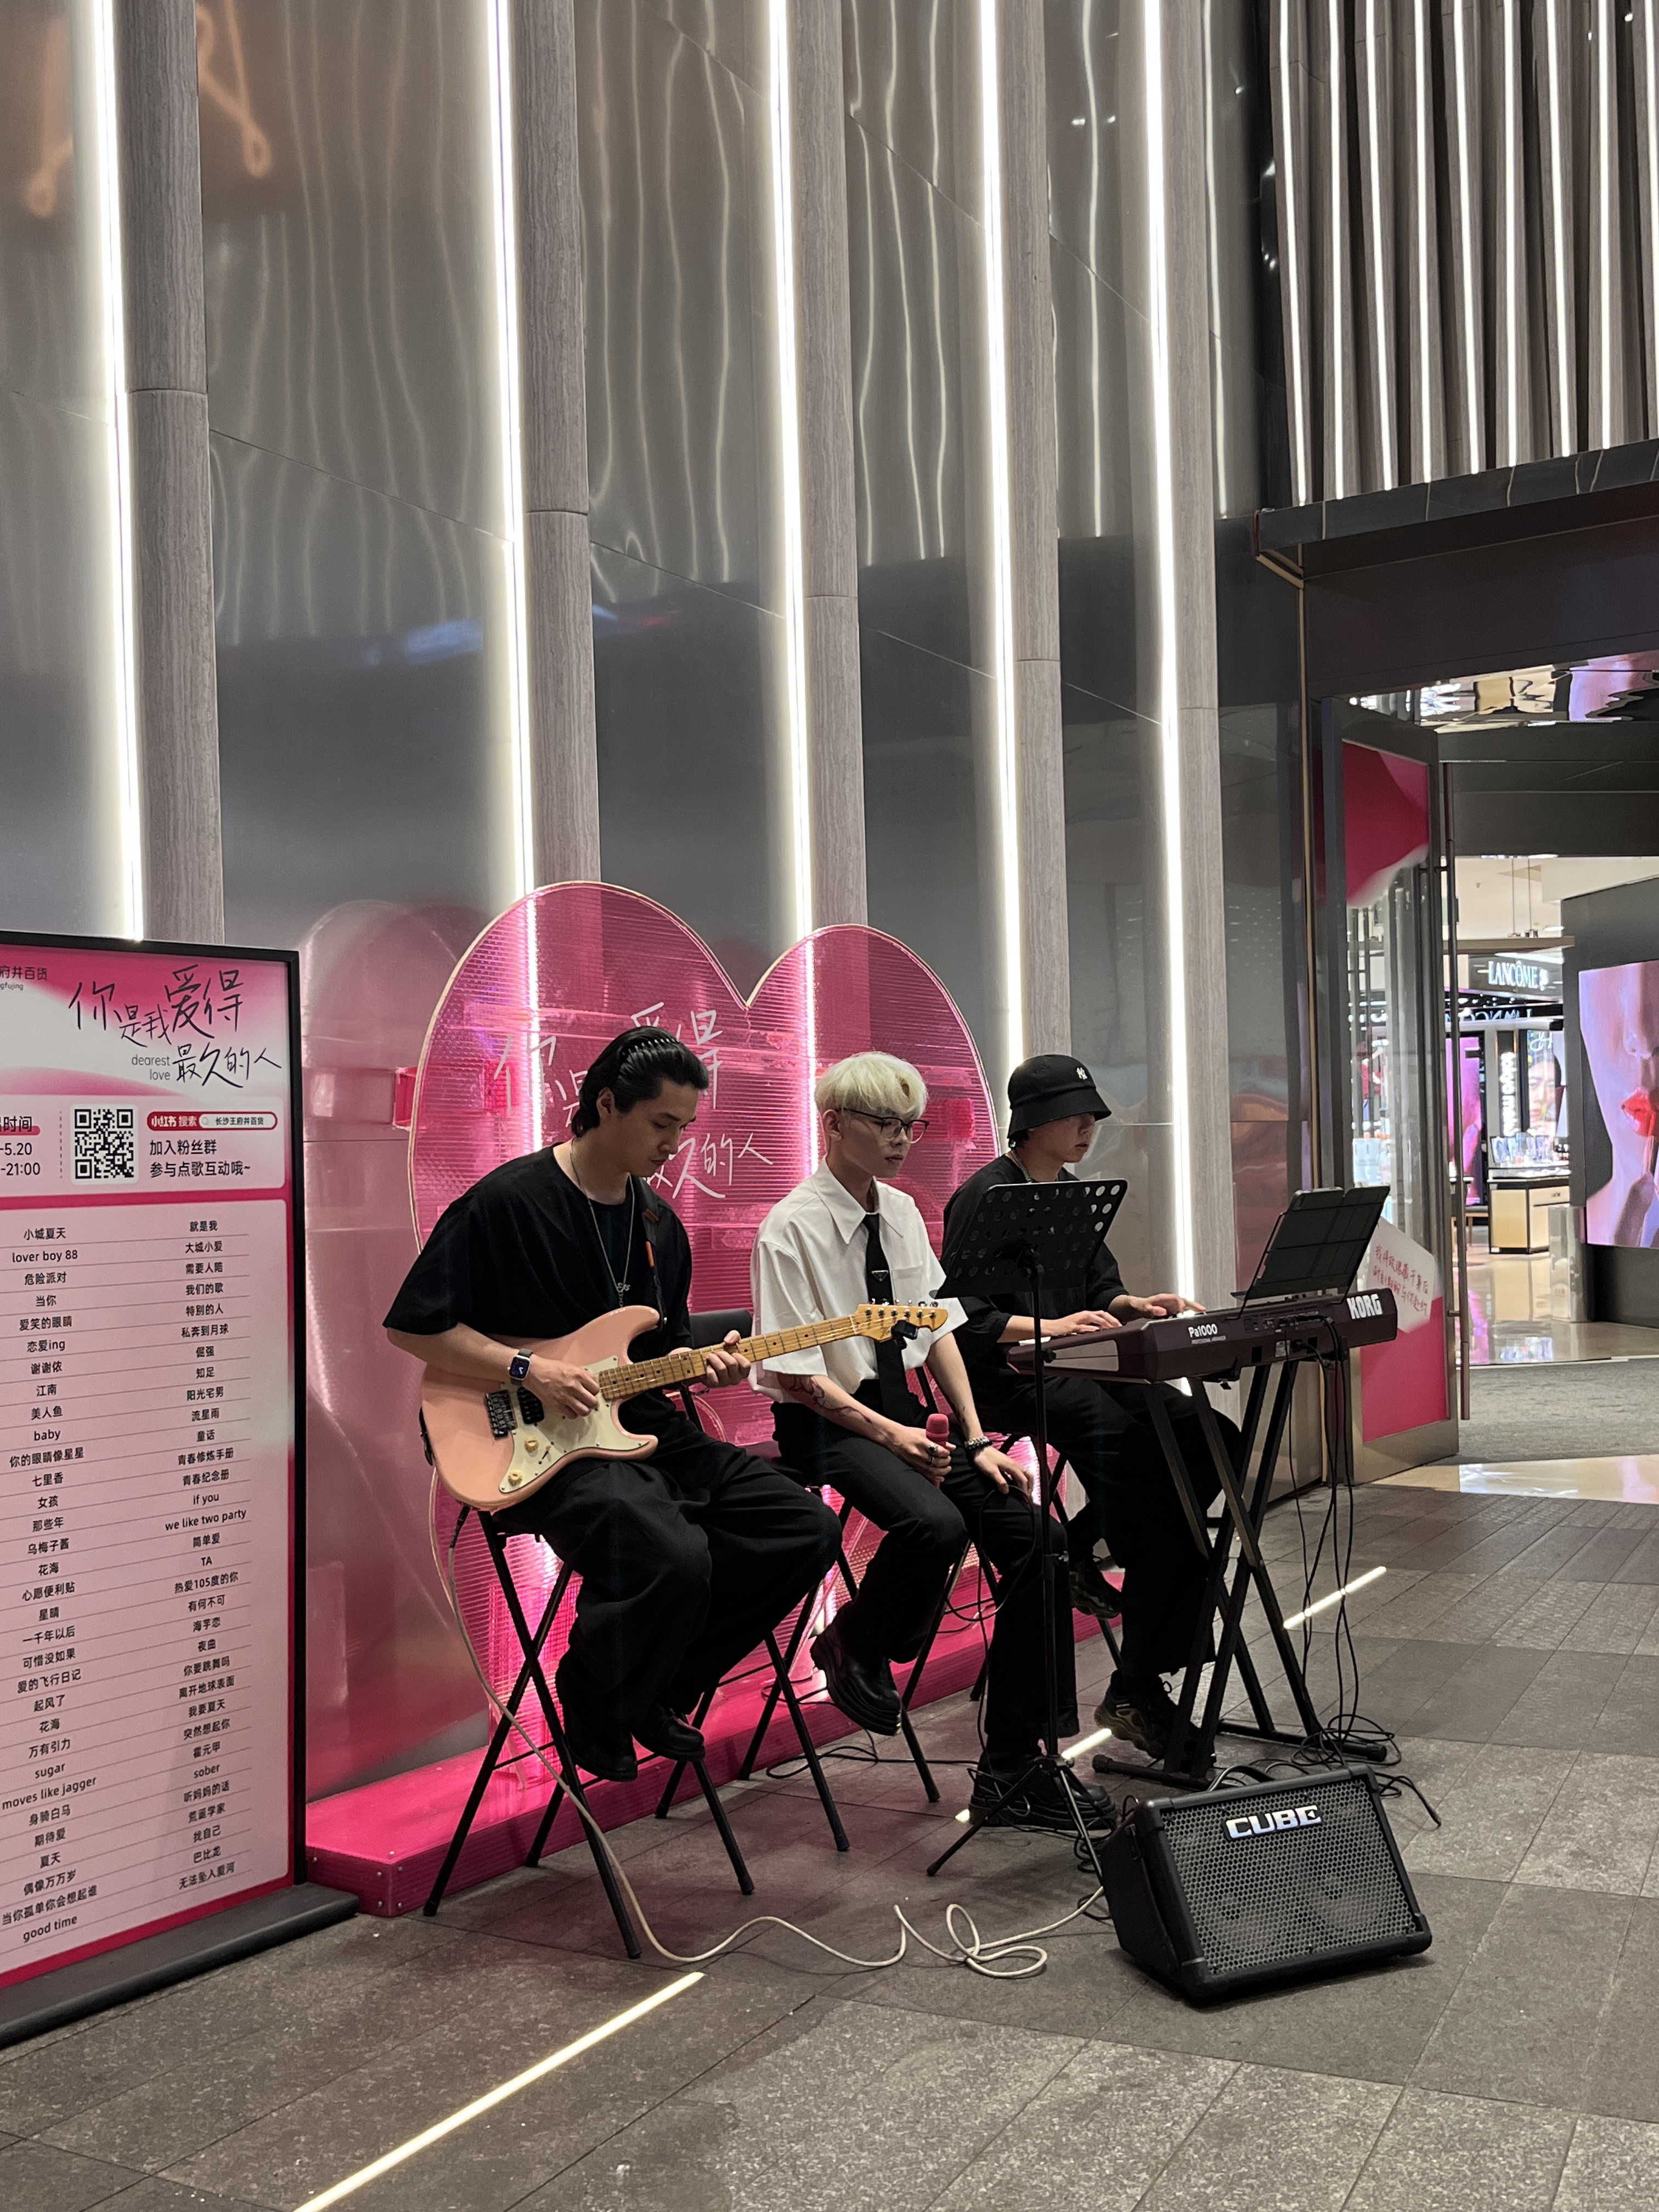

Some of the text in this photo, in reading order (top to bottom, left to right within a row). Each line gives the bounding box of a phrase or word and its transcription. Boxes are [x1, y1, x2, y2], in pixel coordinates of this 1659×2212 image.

[1488, 960, 1538, 989] LANCÔME
[132, 1054, 171, 1066] dearest
[172, 1042, 282, 1088] 最久的人
[149, 1070, 171, 1081] love
[0, 1116, 32, 1132] 时间
[151, 1115, 197, 1127] 小红书 搜索
[216, 1117, 264, 1126] 长沙王府井百货
[149, 1139, 217, 1155] 加入粉丝群
[190, 1220, 218, 1232] 就是我
[24, 1228, 66, 1240] 小城夏天
[185, 1240, 223, 1254] 大城小爱
[13, 1250, 77, 1262] lover boy 88
[186, 1262, 223, 1274] 需要人陪
[25, 1271, 66, 1285] 危险派对
[186, 1283, 223, 1295] 我们的歌
[36, 1295, 57, 1307] 当你
[1346, 1294, 1383, 1319] KORG
[186, 1303, 223, 1317] 特别的人
[20, 1316, 72, 1331] 爱笑的眼睛
[182, 1323, 228, 1338] 私奔到月球
[1188, 1323, 1218, 1338] Pa1000
[27, 1340, 65, 1352] 恋爱ing
[196, 1346, 215, 1358] 倔强
[196, 1367, 215, 1379] 知足
[36, 1384, 57, 1397] 江南
[187, 1386, 223, 1401] 阳光宅男
[31, 1406, 63, 1420] 美人鱼
[192, 1408, 219, 1421] 流星雨
[34, 1429, 60, 1441] baby
[197, 1429, 215, 1442] 童话
[9, 1447, 84, 1467] 你的眼睛像星星
[178, 1447, 234, 1465] 青春修炼手册
[32, 1471, 63, 1487] 七里香
[183, 1469, 229, 1486] 青春纪念册
[38, 1495, 58, 1509] 女孩
[194, 1494, 219, 1505] if you
[32, 1517, 64, 1532] 那些年
[165, 1510, 246, 1531] we like two party
[27, 1538, 69, 1555] 乌梅子酱
[193, 1533, 221, 1548] 简单爱
[201, 1556, 212, 1566] TA
[38, 1562, 59, 1576] 花海
[174, 1572, 238, 1594] 热爱105度的你
[22, 1581, 75, 1601] 心愿便利贴
[188, 1594, 225, 1612] 有何不可
[39, 1607, 59, 1621] 星晴
[193, 1617, 221, 1632] 海芋恋
[22, 1625, 75, 1644] 一千年以后
[198, 1639, 216, 1652] 夜曲
[22, 1648, 76, 1668] 可惜没如果
[18, 1669, 81, 1694] 爱的飞行日记
[179, 1675, 234, 1699] 离开地球表面
[34, 1694, 65, 1712] 起风了
[189, 1699, 225, 1718] 我要夏天
[39, 1718, 60, 1733] 花海
[184, 1719, 230, 1740] 突然想起你
[29, 1739, 70, 1758] 万有引力
[35, 1763, 65, 1779] sugar
[194, 1765, 219, 1778] sober
[2, 1778, 96, 1809] moves like jagger
[184, 1780, 229, 1802] 听妈妈的话
[29, 1804, 70, 1826] 身骑白马
[1226, 1805, 1322, 1839] CUBE
[35, 1827, 65, 1847] 期待爱
[194, 1825, 221, 1843] 找自己
[40, 1852, 60, 1868] 夏天
[2, 1885, 97, 1925] 当你孤单你会想起谁
[24, 1916, 77, 1943] good time
